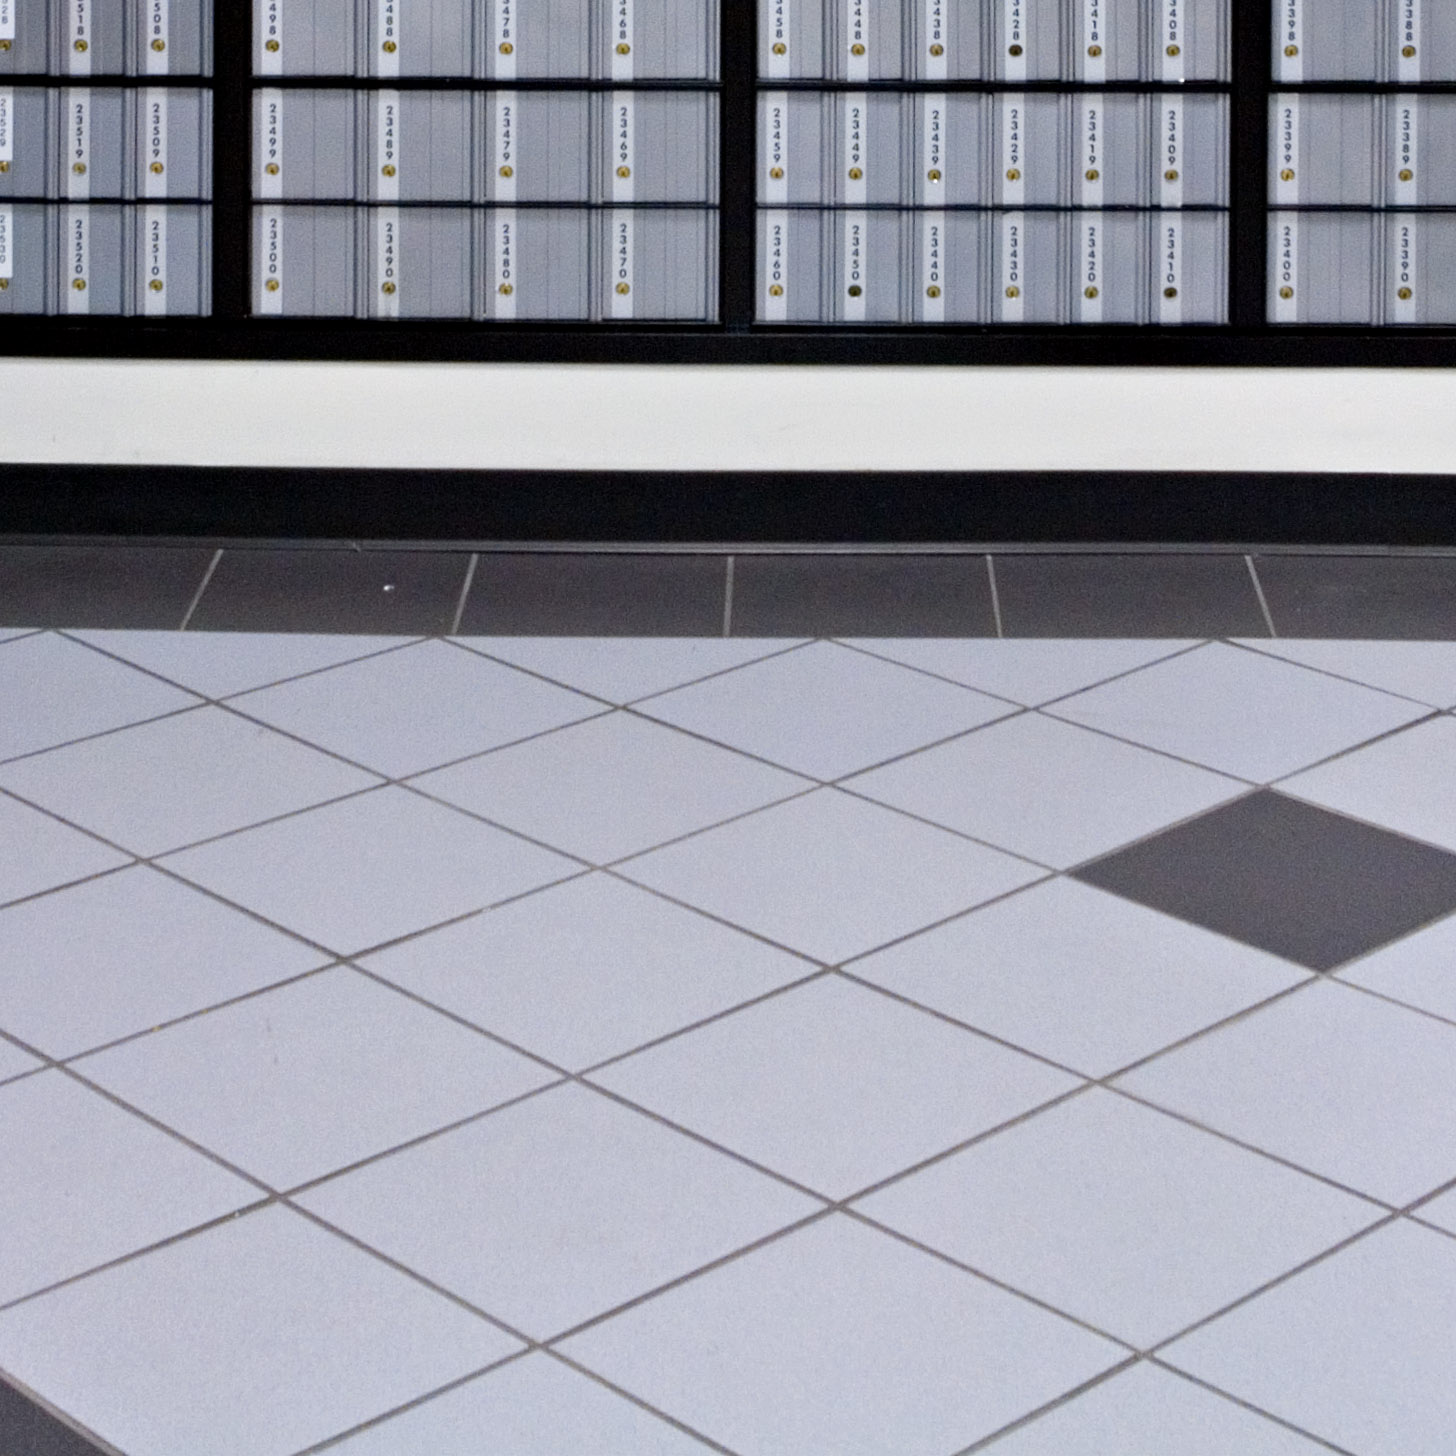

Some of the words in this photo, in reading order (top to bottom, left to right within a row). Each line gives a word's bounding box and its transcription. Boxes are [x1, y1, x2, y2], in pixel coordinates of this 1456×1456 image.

[73, 104, 84, 158] 23519
[268, 103, 279, 159] 23499
[502, 107, 513, 162] 23479
[772, 108, 783, 163] 23459
[930, 110, 941, 165] 23439
[1087, 110, 1098, 165] 23419
[1283, 108, 1294, 164] 23399
[149, 220, 160, 276] 23510
[385, 222, 396, 277] 23490
[617, 223, 628, 279] 23470
[850, 225, 861, 281] 23450
[1009, 226, 1020, 282] 23430
[1165, 228, 1176, 283] 23410
[1399, 227, 1410, 282] 23390
